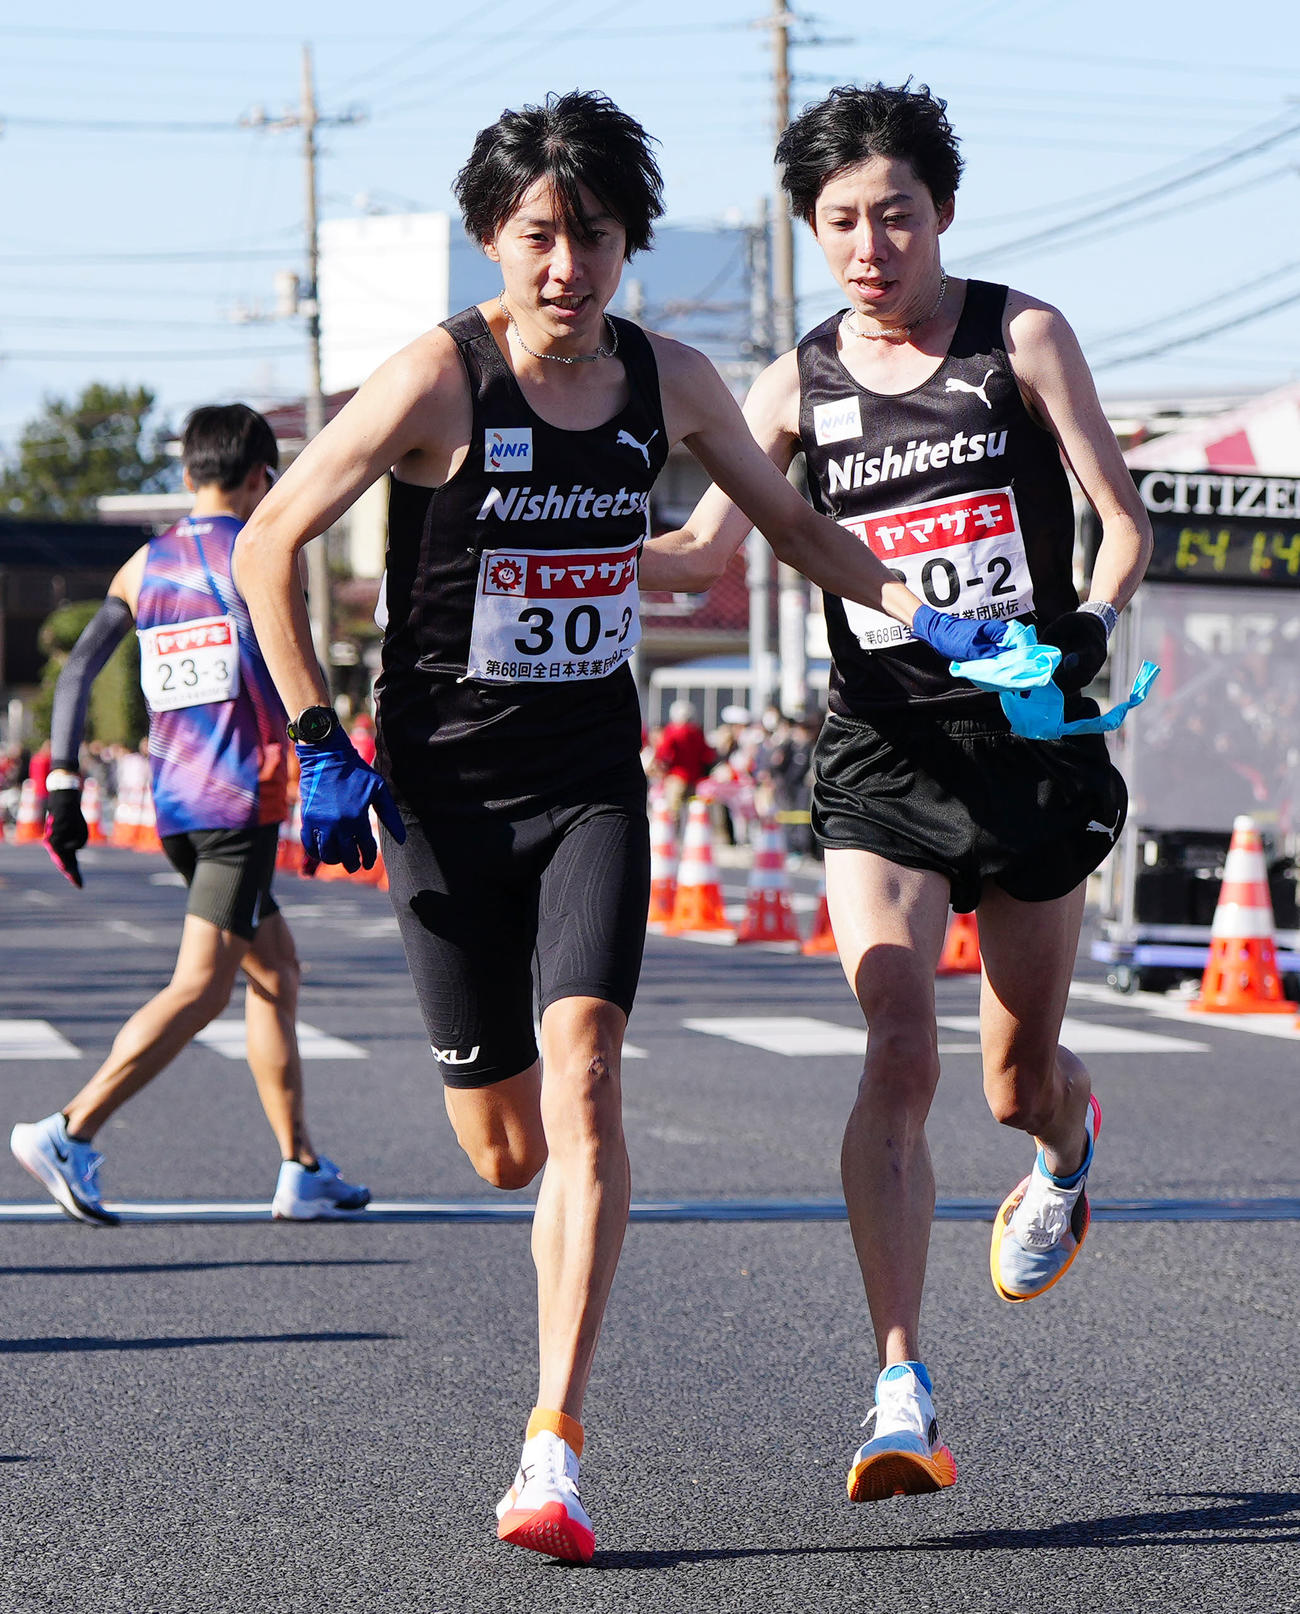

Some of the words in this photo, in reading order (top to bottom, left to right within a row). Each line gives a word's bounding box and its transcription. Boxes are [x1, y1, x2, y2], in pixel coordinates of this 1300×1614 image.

[819, 411, 856, 431] NNR
[490, 442, 529, 458] NNR
[828, 430, 1008, 494] Nishitetsu
[476, 484, 650, 521] Nishitetsu
[1139, 471, 1300, 519] CITIZE
[875, 503, 1003, 550] ヤマザキ
[514, 604, 633, 656] 30-3
[158, 658, 229, 691] 23-3
